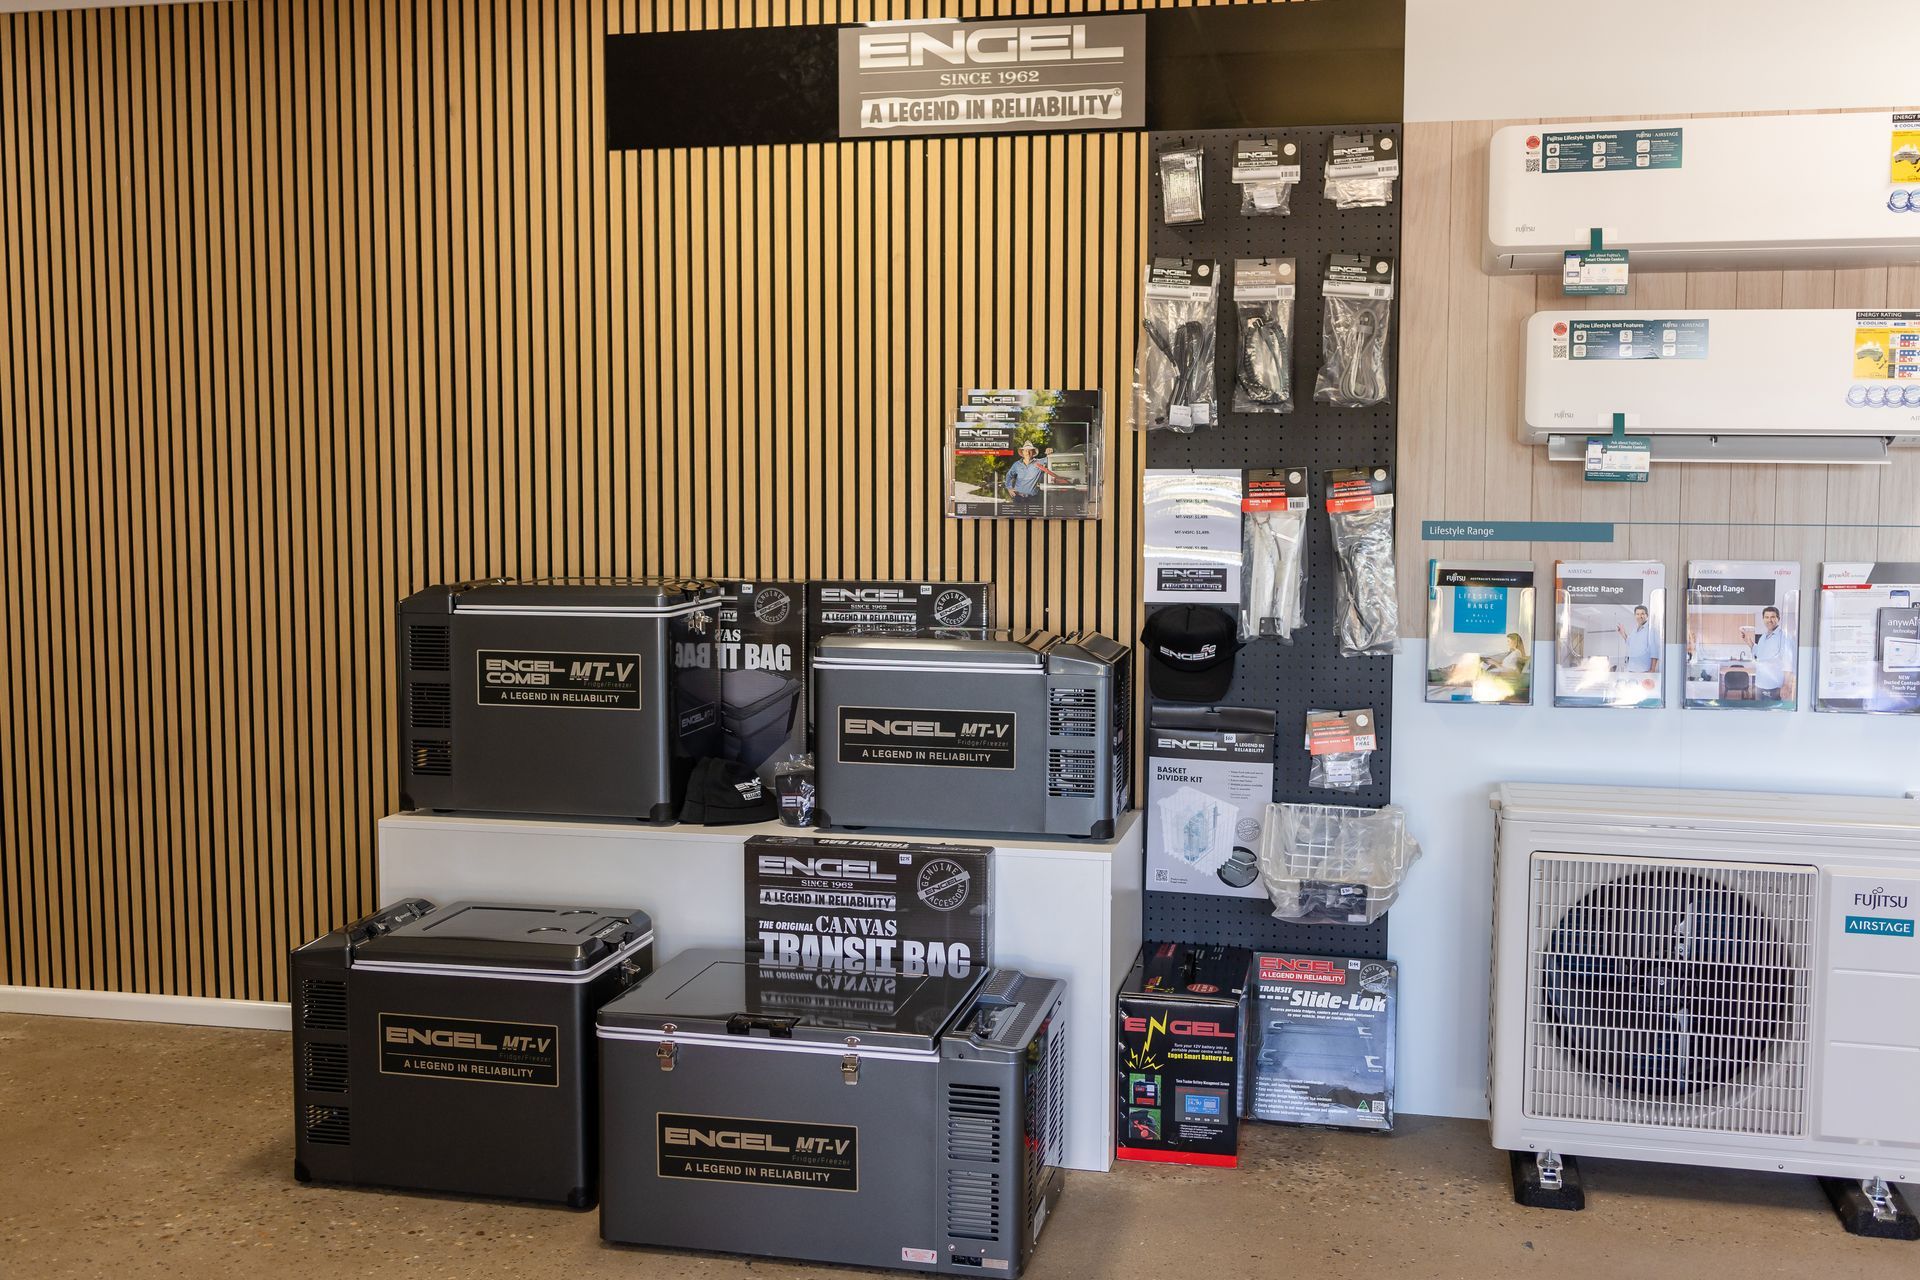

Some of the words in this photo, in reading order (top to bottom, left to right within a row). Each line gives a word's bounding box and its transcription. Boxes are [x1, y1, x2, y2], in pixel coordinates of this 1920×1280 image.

[859, 24, 1124, 69] ENGEL
[940, 72, 992, 86] SINCE
[998, 70, 1040, 85] 1962
[869, 103, 882, 123] A
[889, 100, 960, 123] LEGEND
[966, 99, 985, 119] IN
[992, 94, 1113, 119] RELIABILITY
[1333, 147, 1375, 155] ENGEL
[1516, 224, 1536, 233] FUJITSU
[1153, 268, 1191, 277] ENGEL
[1330, 266, 1368, 274] ENGEL
[972, 396, 1021, 404] ENGEL
[964, 412, 1015, 421] ENGEL
[959, 429, 1010, 437] ENGEL
[1429, 526, 1465, 537] Lifestyle
[1467, 527, 1495, 537] Range
[1162, 569, 1223, 578] ENGEL
[1446, 572, 1466, 583] FUJITSU
[820, 588, 917, 603] ENGEL
[1567, 585, 1599, 593] Cassette
[1600, 585, 1624, 594] Range
[1697, 584, 1721, 593] Ducted
[1722, 585, 1745, 594] Range
[757, 590, 783, 609] GENUINE
[937, 592, 964, 611] GENUINE
[762, 605, 787, 622] ACCESSORY
[831, 613, 859, 622] LEGEND
[869, 614, 914, 623] RELIABILITY
[942, 607, 969, 625] ACCESSORY
[745, 643, 791, 671] BAG
[1160, 645, 1216, 661] ENGEL
[485, 659, 566, 673] ENGEL
[569, 661, 635, 682] MT-V
[486, 672, 550, 685] COMBI
[583, 680, 633, 688] Fridge/Freezer
[500, 691, 508, 699] A
[510, 691, 547, 700] LEGEND
[550, 693, 560, 701] IN
[562, 693, 620, 703] RELIABILITY
[844, 718, 956, 738] ENGEL
[960, 722, 1009, 738] MT-V
[957, 739, 1009, 747] Fridge/Freezer
[1158, 738, 1227, 752] ENGEL
[862, 749, 869, 757] A
[872, 749, 913, 758] LEGEND
[916, 751, 926, 759] IN
[929, 751, 992, 762] RELIABILITY
[1157, 766, 1187, 774] BASKET
[1157, 773, 1189, 782] DIVIDER
[758, 855, 897, 881] ENGEL
[921, 862, 959, 887] GENUINE
[801, 879, 829, 888] SINCE
[831, 881, 854, 889] 1962
[924, 876, 962, 896] ENGEL
[764, 893, 772, 902] A
[774, 893, 812, 905] LEGEND
[815, 895, 826, 905] IN
[828, 895, 892, 909] RELIABILITY
[928, 883, 965, 907] ACCESSORY
[1854, 886, 1908, 910] FUJITSU
[758, 920, 774, 929] THE
[775, 921, 814, 932] ORIGINAL
[815, 915, 898, 937] CANVAS
[1849, 920, 1911, 933] AIRSTAGE
[1259, 956, 1346, 974] ENGEL
[1303, 974, 1344, 982] RELIABILITY
[1259, 985, 1292, 993] TRANSIT
[1290, 989, 1387, 1012] Slide-Lok
[1124, 1010, 1236, 1039] ENGEL
[386, 1026, 498, 1050] ENGEL
[502, 1035, 551, 1053] MT-V
[1167, 1052, 1183, 1060] Engel
[1201, 1054, 1222, 1062] Battery
[403, 1059, 411, 1068] A
[414, 1060, 455, 1072] LEGEND
[457, 1064, 468, 1073] IN
[471, 1065, 534, 1078] RELIABILITY
[664, 1127, 790, 1153] ENGEL
[795, 1136, 850, 1155] MT-V
[791, 1154, 850, 1165] Fridge/Freezer
[685, 1162, 692, 1172] A
[696, 1164, 741, 1175] LEGEND
[745, 1167, 757, 1177] IN
[760, 1168, 830, 1182] RELIABILITY
